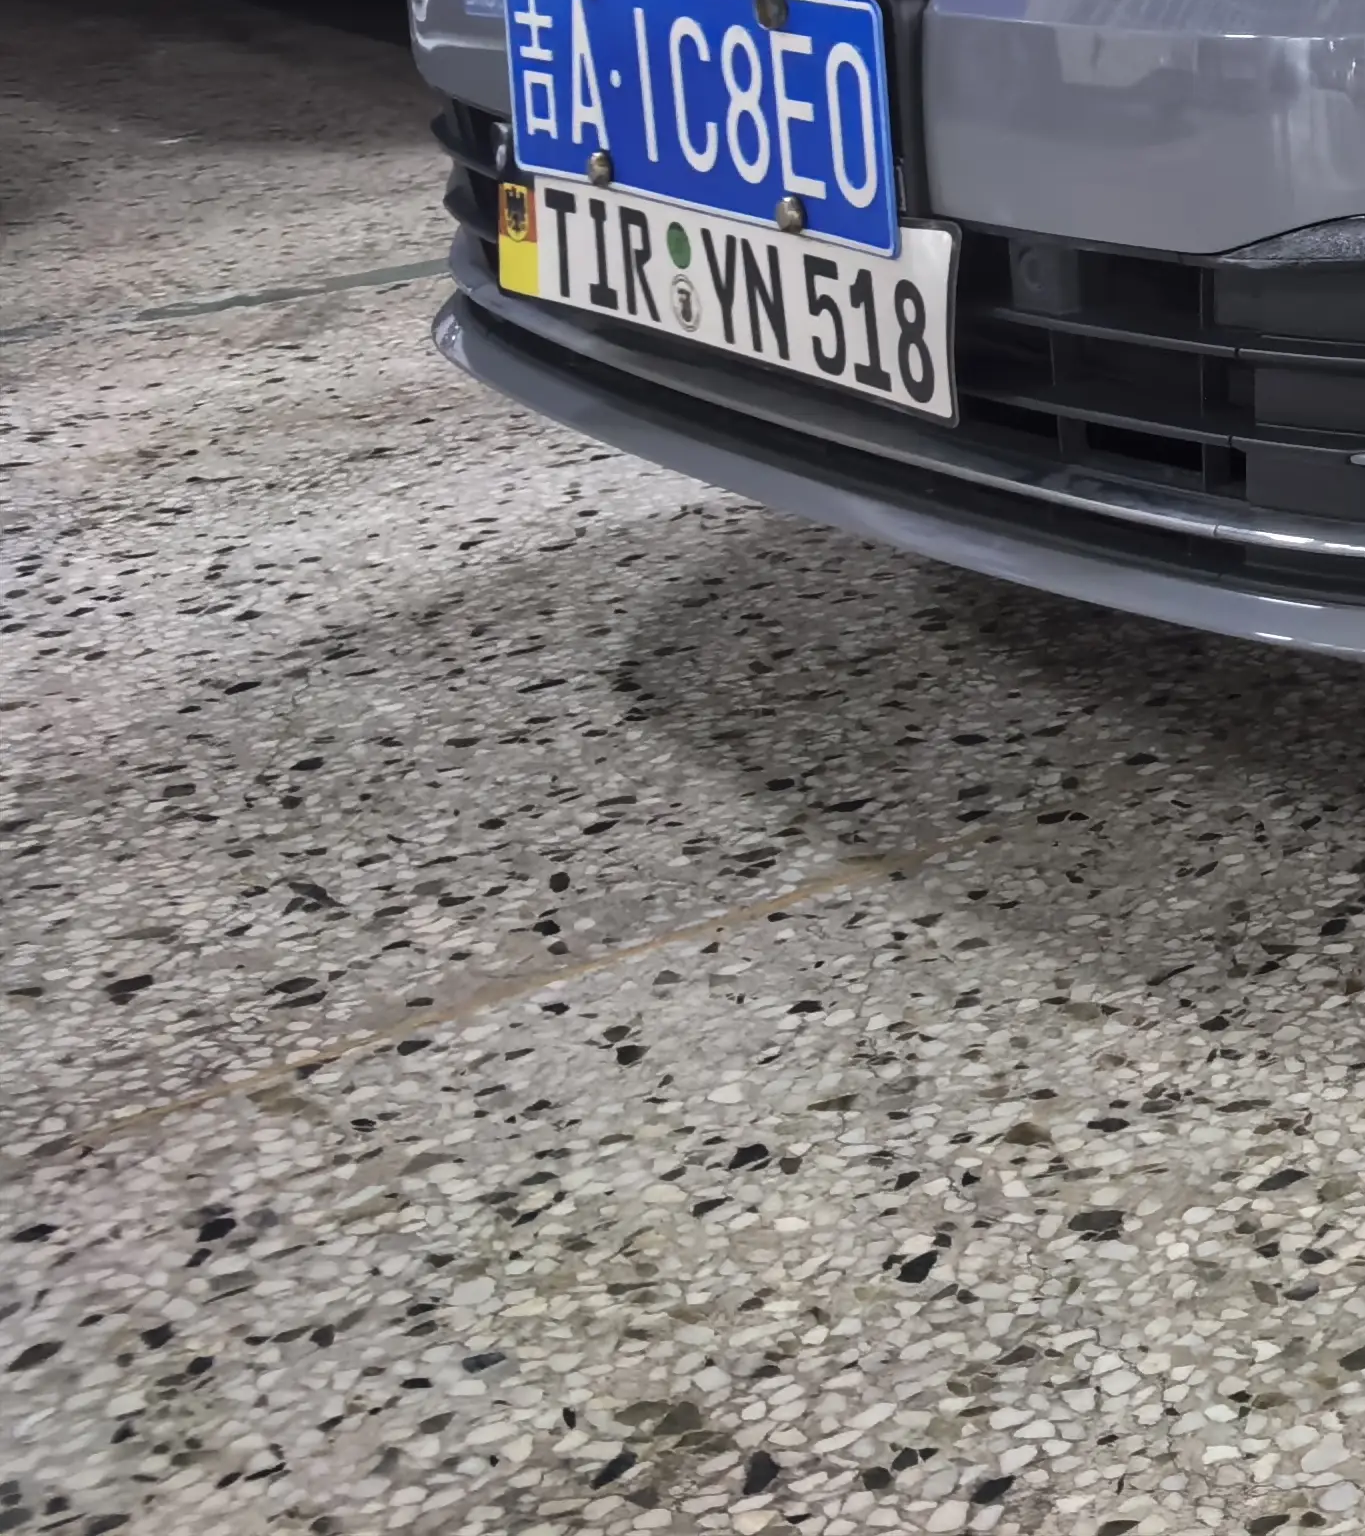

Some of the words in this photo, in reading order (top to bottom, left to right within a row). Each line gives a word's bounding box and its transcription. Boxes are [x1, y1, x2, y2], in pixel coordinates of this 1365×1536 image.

[544, 186, 661, 323] TIR
[702, 227, 791, 361] YN
[803, 254, 936, 405] 518
